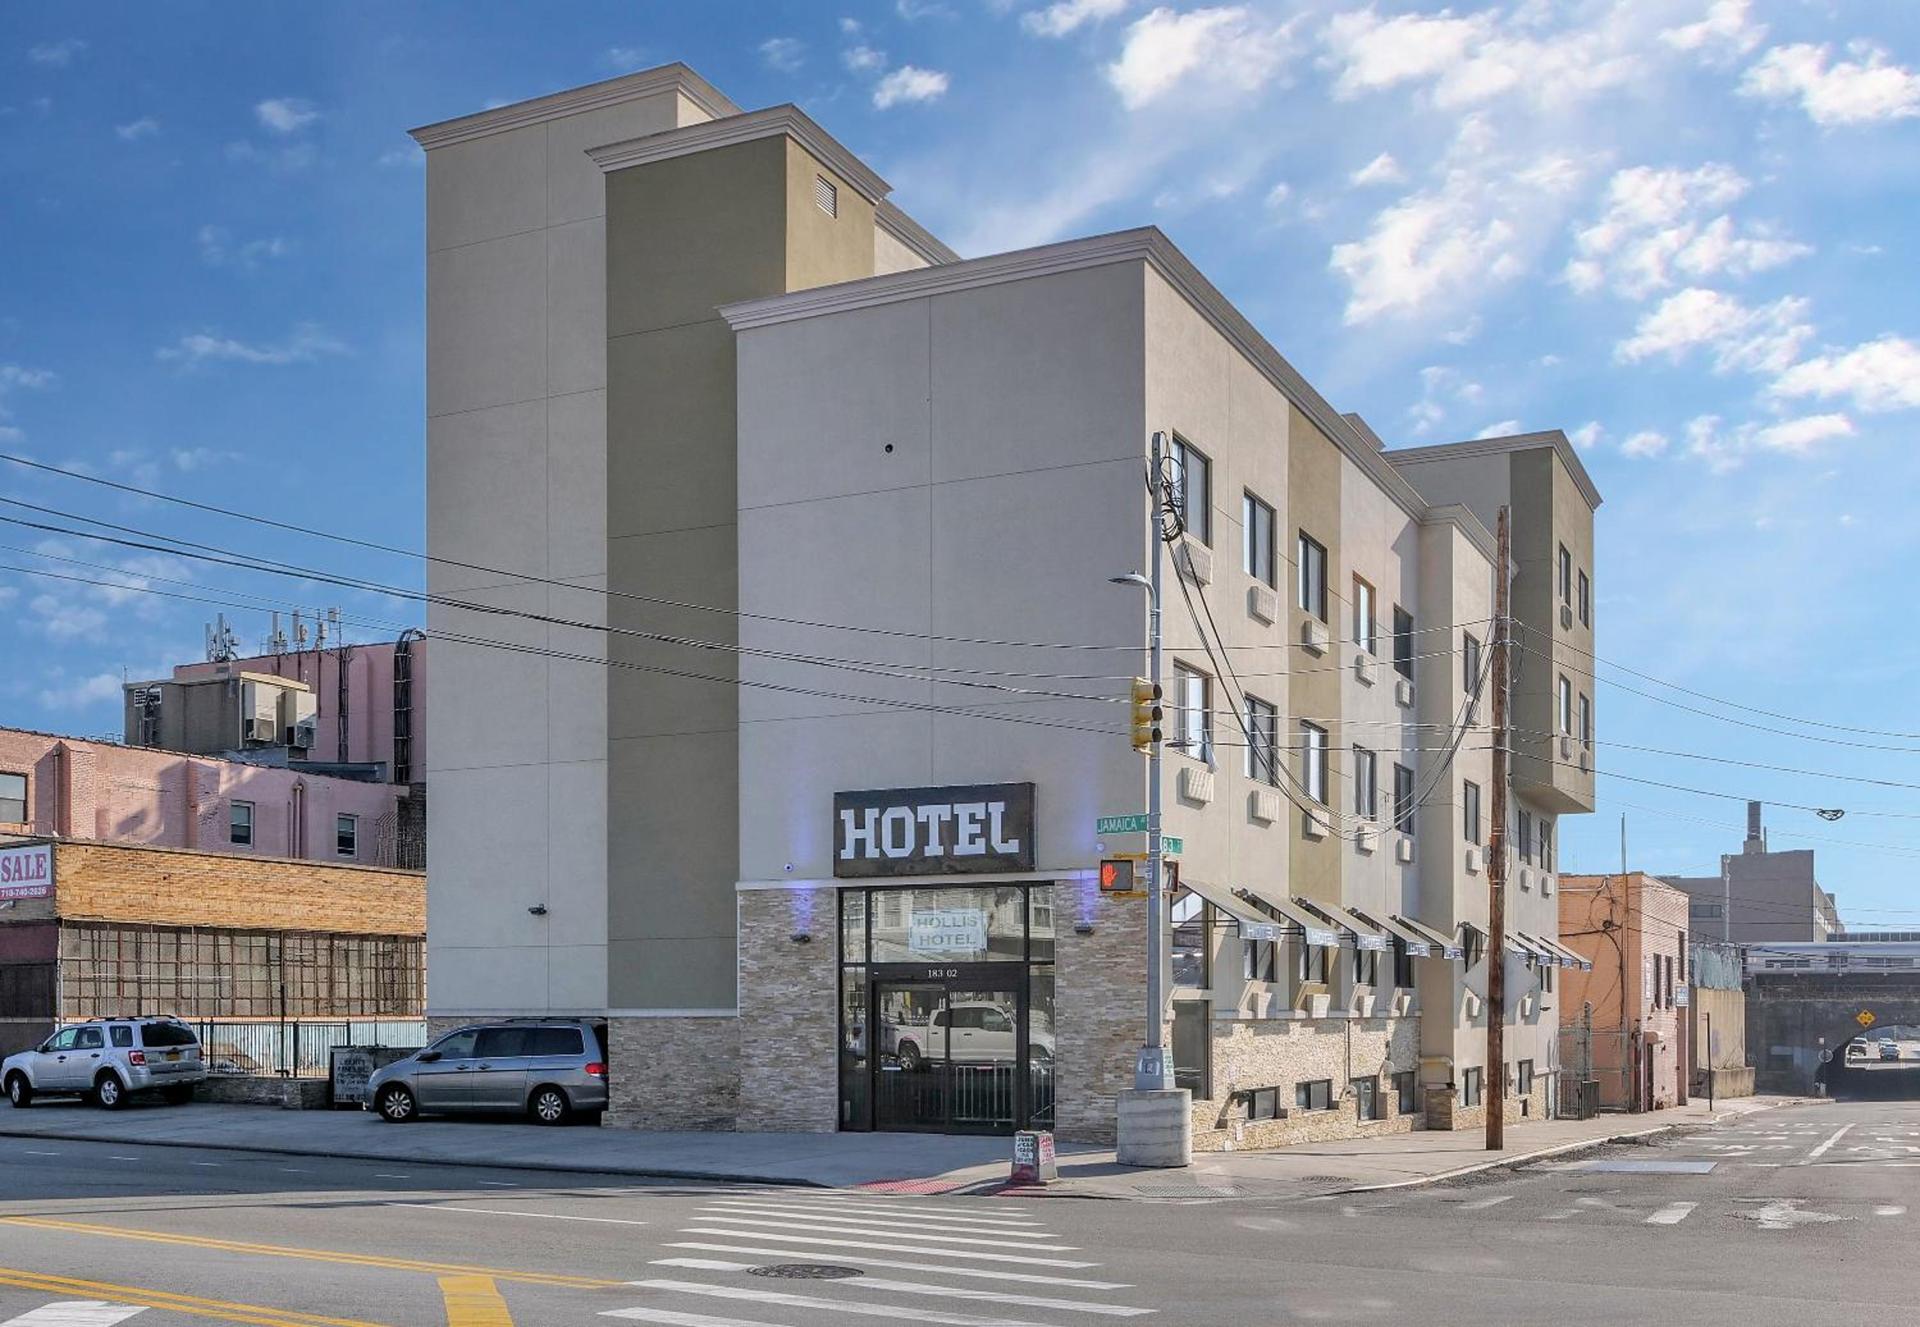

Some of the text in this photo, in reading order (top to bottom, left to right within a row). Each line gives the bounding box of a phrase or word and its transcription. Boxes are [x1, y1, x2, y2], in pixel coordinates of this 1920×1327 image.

[840, 801, 1020, 860] HOTEL
[1098, 817, 1138, 833] JAMAICA
[1162, 838, 1174, 852] 83
[1, 853, 47, 883] SALE
[917, 915, 978, 929] HOLLIS
[920, 933, 977, 946] HOTEL
[928, 968, 957, 979] 183 02
